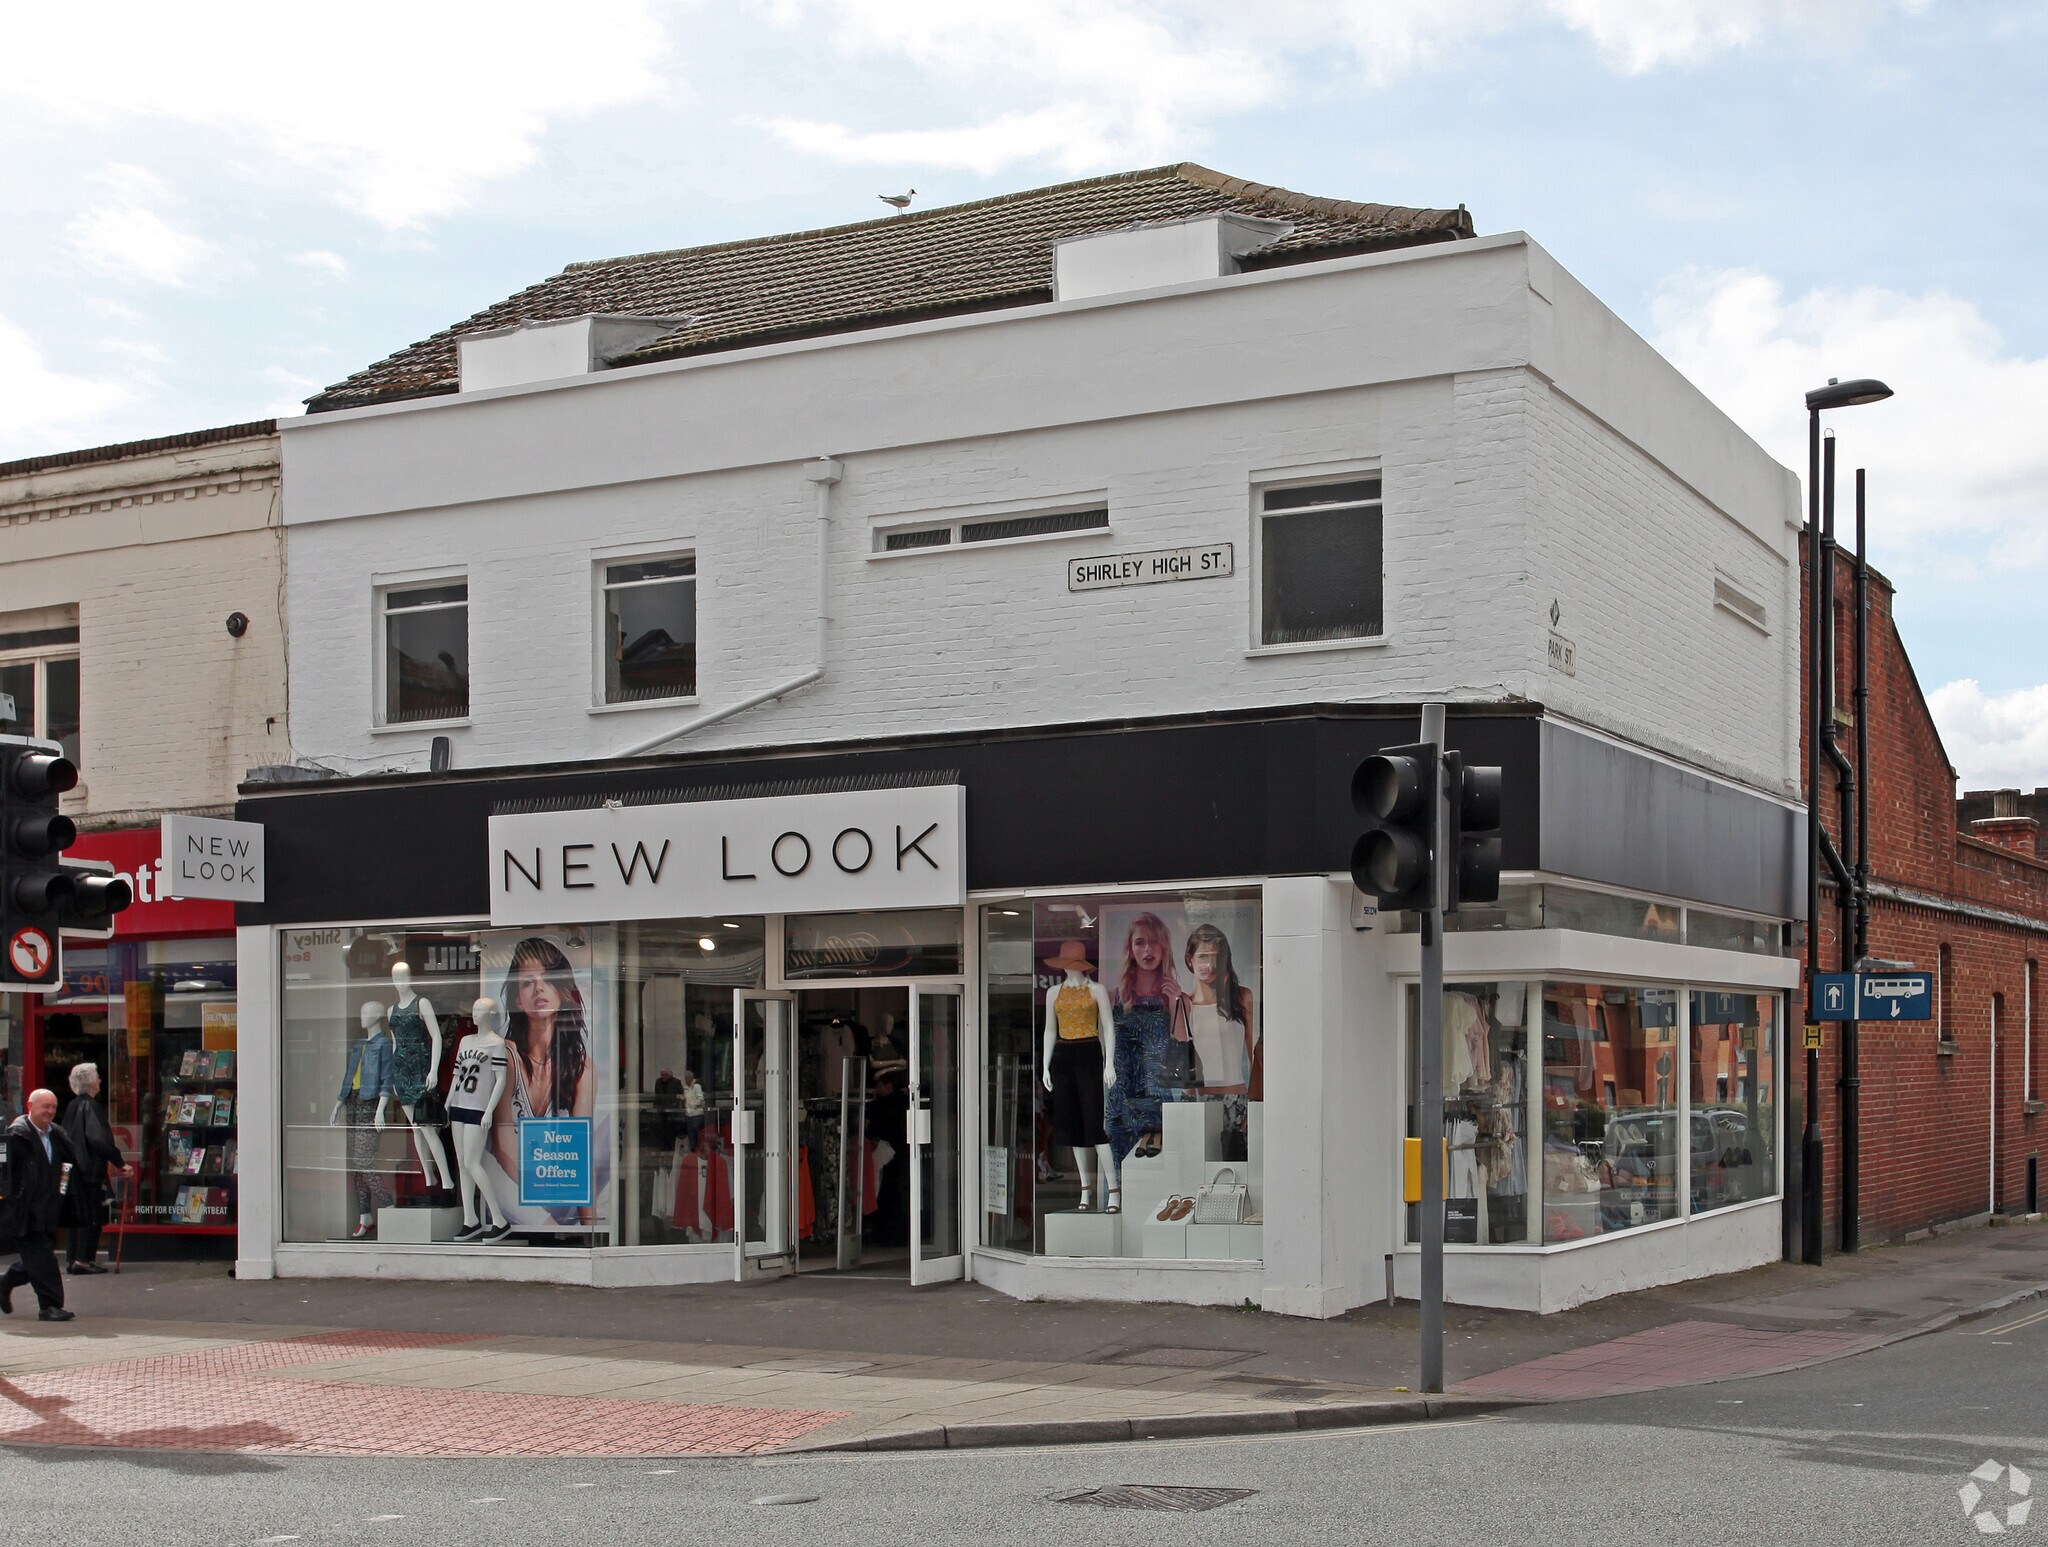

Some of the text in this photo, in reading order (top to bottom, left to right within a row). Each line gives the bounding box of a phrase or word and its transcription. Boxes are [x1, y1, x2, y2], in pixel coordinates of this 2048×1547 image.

[1076, 552, 1226, 583] SHIRLEY HIGH ST.
[1547, 638, 1575, 666] PARK ST.
[188, 835, 250, 858] NEW
[503, 822, 939, 892] NEW LOOK
[182, 860, 256, 884] LOOK
[543, 1131, 573, 1143] New
[533, 1148, 580, 1161] Season
[535, 1165, 577, 1178] Offers
[135, 1205, 154, 1214] FIGHT
[154, 1205, 168, 1214] FOR
